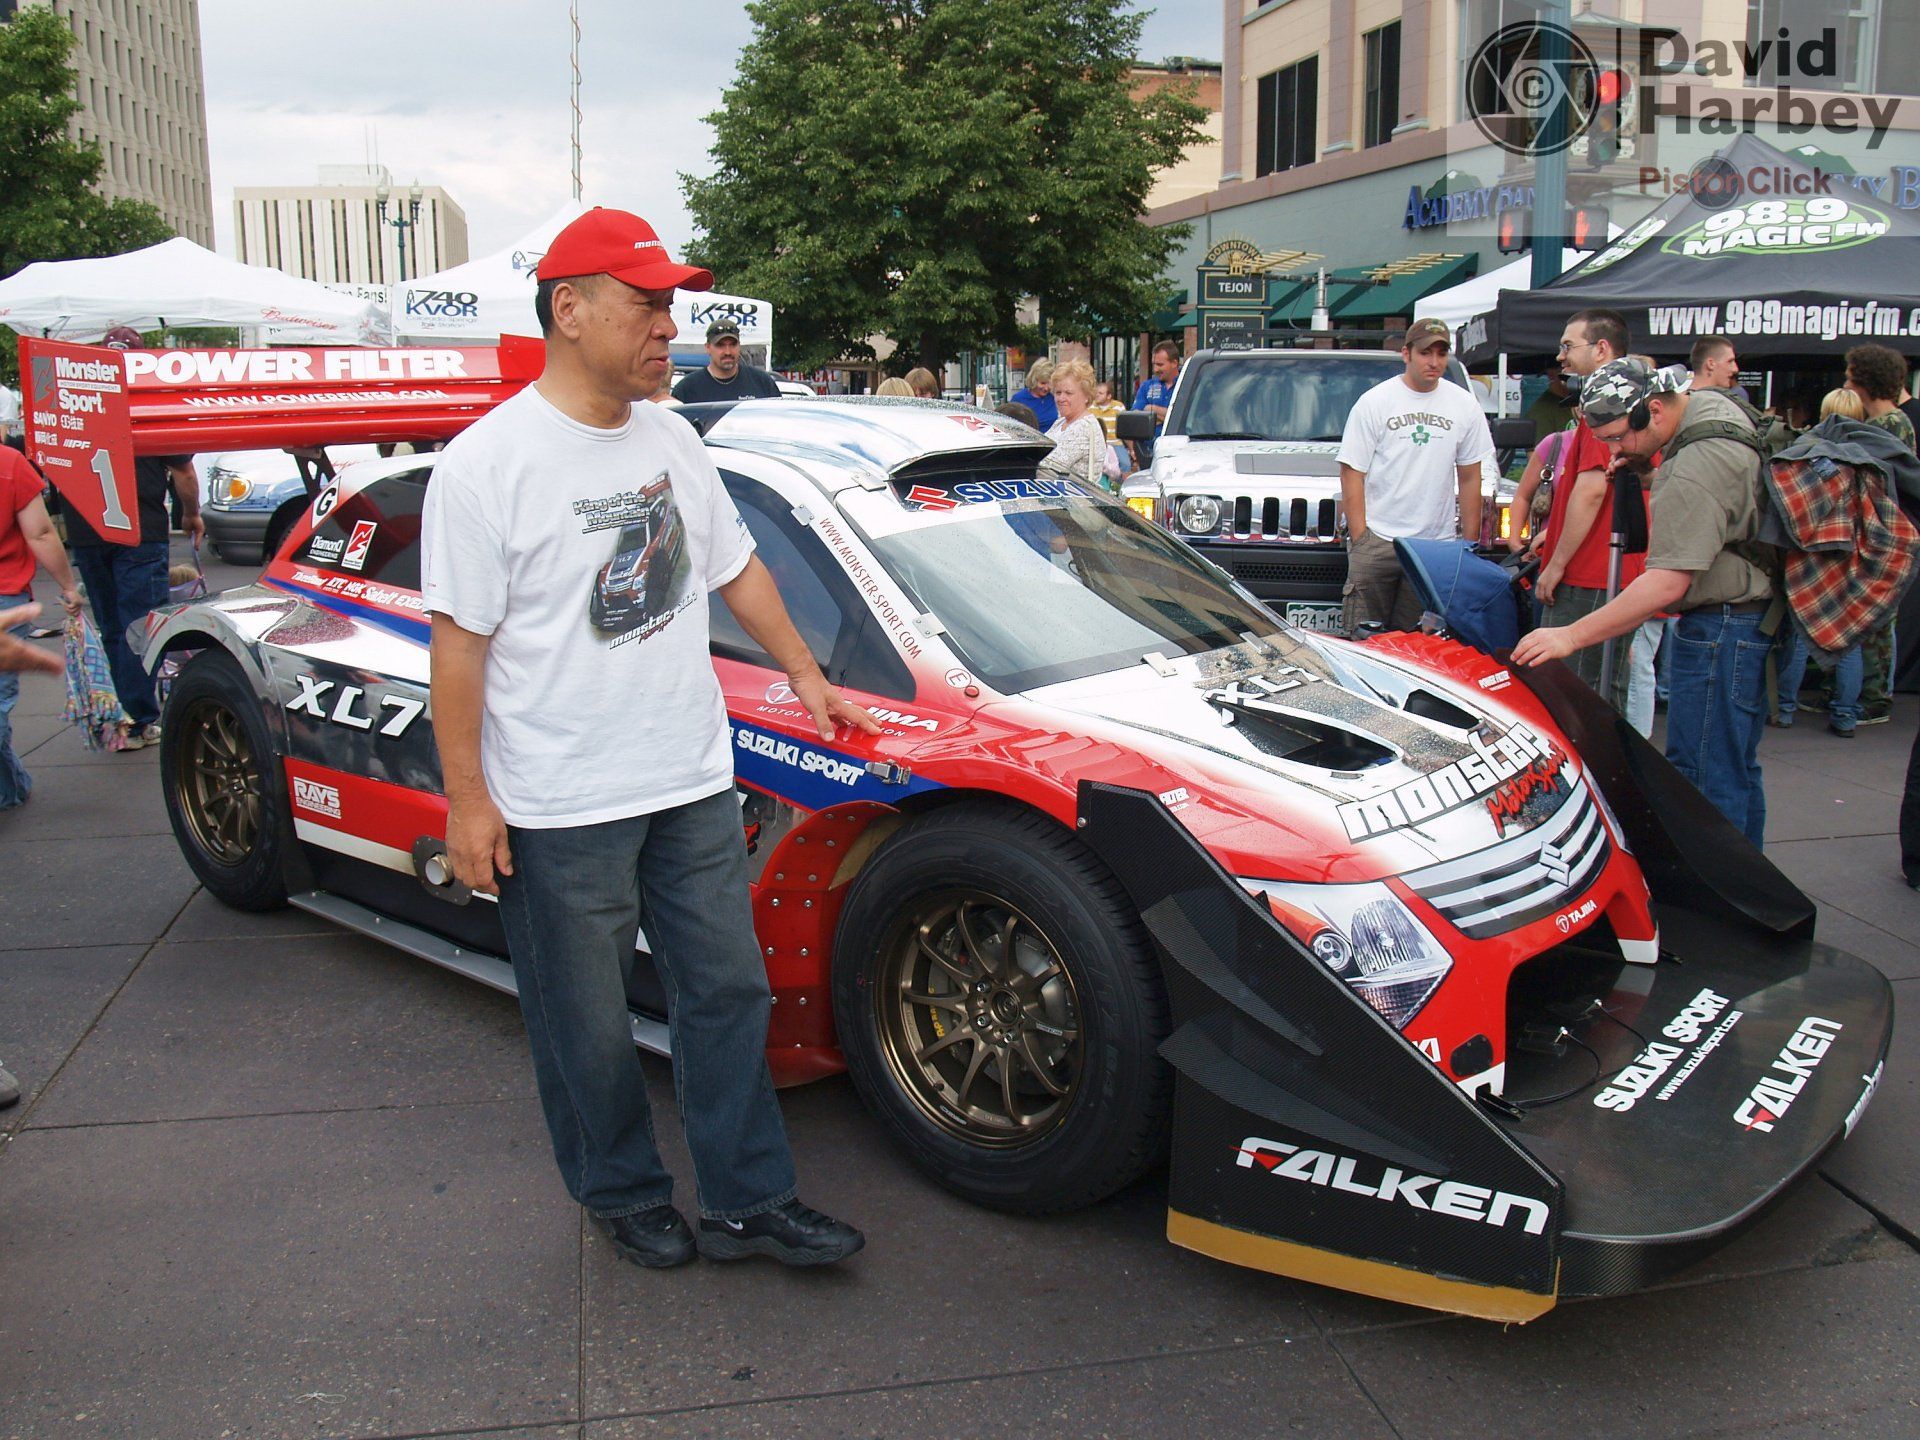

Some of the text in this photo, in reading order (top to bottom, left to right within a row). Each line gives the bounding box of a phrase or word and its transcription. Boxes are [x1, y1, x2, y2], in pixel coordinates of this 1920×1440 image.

[1704, 198, 1848, 238] 98.9
[1682, 225, 1830, 256] MAGIC
[1834, 221, 1886, 237] FM
[415, 290, 478, 306] 740
[1218, 282, 1252, 293] TEJON
[406, 303, 478, 317] KVOR
[55, 356, 119, 381] Monster
[125, 349, 468, 384] POWER FILTER
[58, 388, 104, 414] Sport
[33, 411, 57, 427] SANYO
[1386, 412, 1453, 431] GUINNESS
[91, 448, 131, 529] 1
[316, 487, 337, 517] G
[954, 478, 1092, 502] SUZUKI
[573, 492, 646, 515] King of the
[586, 504, 650, 527] Mountain
[819, 518, 922, 660] WWW.MONSTER-SPORT.COM
[286, 674, 425, 737] XL7
[756, 705, 804, 719] MOTOR
[737, 728, 865, 786] SUZUKI SPORT
[294, 780, 340, 808] RAYS
[1336, 721, 1541, 845] monster
[1568, 899, 1597, 924] TAJIMA
[1593, 987, 1730, 1112] SUZUKI SPORT
[1733, 1016, 1843, 1133] FALKEN
[1232, 1136, 1550, 1235] FALKEN
